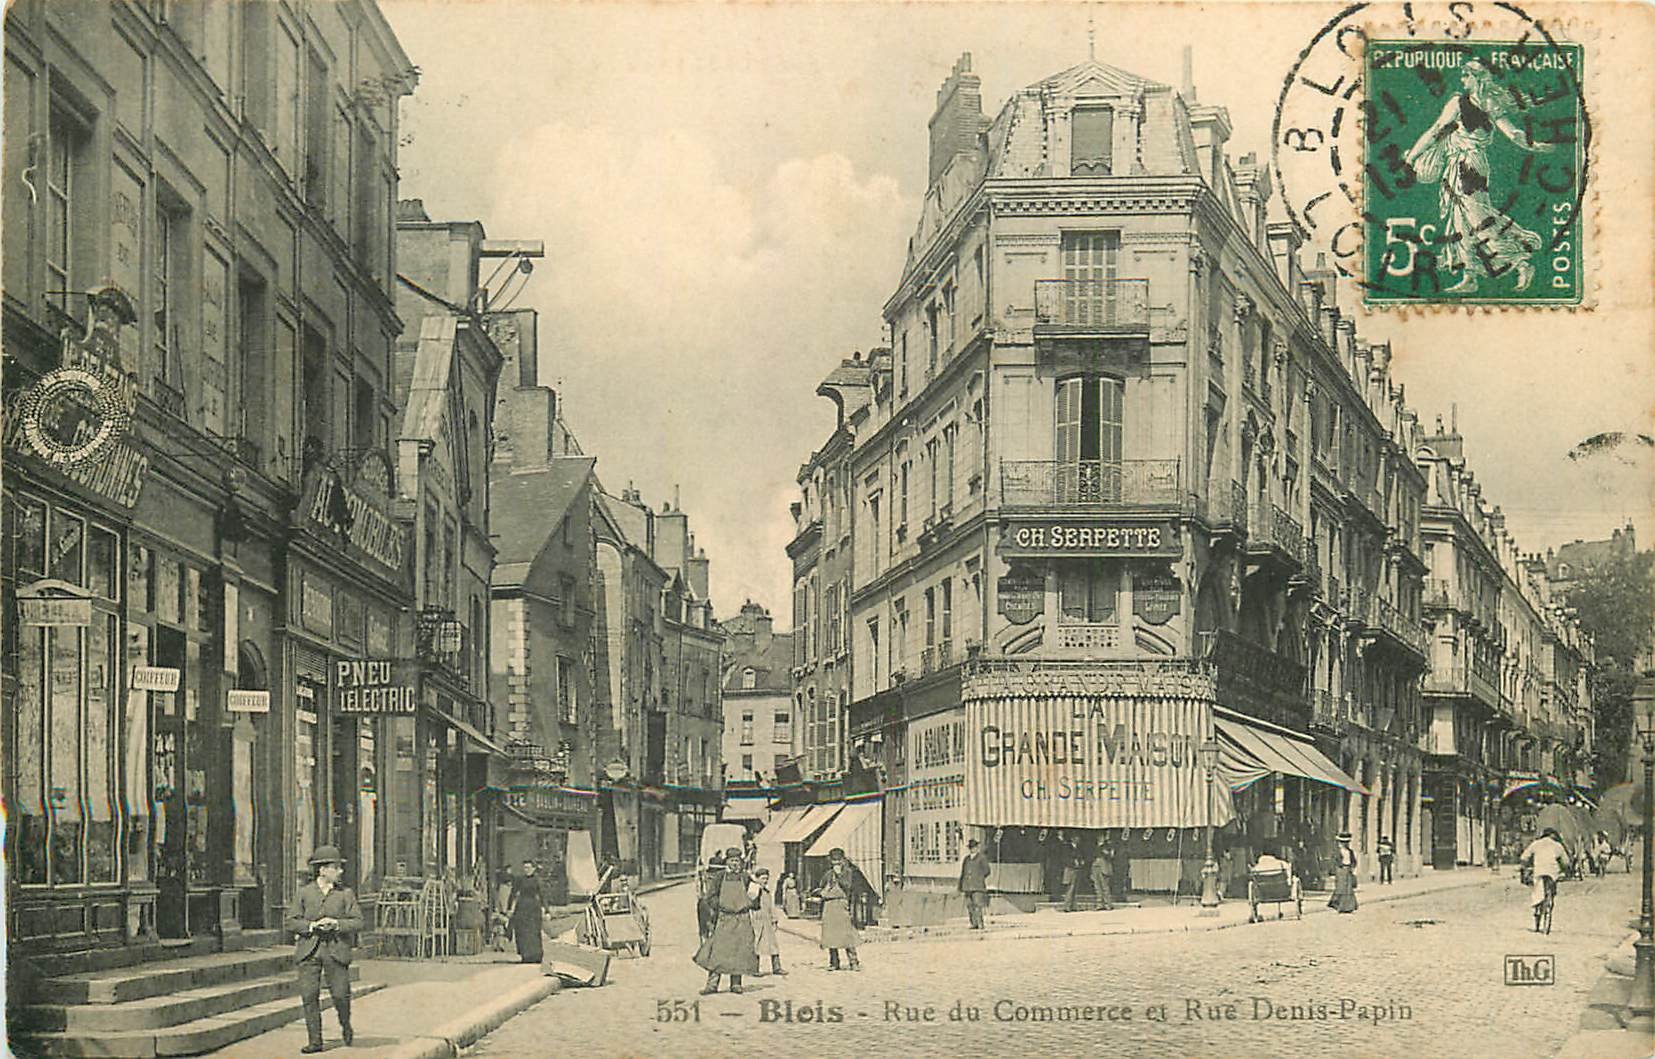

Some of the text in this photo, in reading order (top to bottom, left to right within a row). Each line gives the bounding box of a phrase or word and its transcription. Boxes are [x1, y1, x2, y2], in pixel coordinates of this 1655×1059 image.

[1050, 525, 1162, 549] SERPETTE
[135, 669, 177, 685] COIFFEUR
[337, 660, 391, 687] PNEU
[1072, 699, 1105, 719] LA
[980, 725, 1086, 768] GRANDE
[1097, 723, 1198, 769] MAISON
[1057, 775, 1154, 801] SERPETTE
